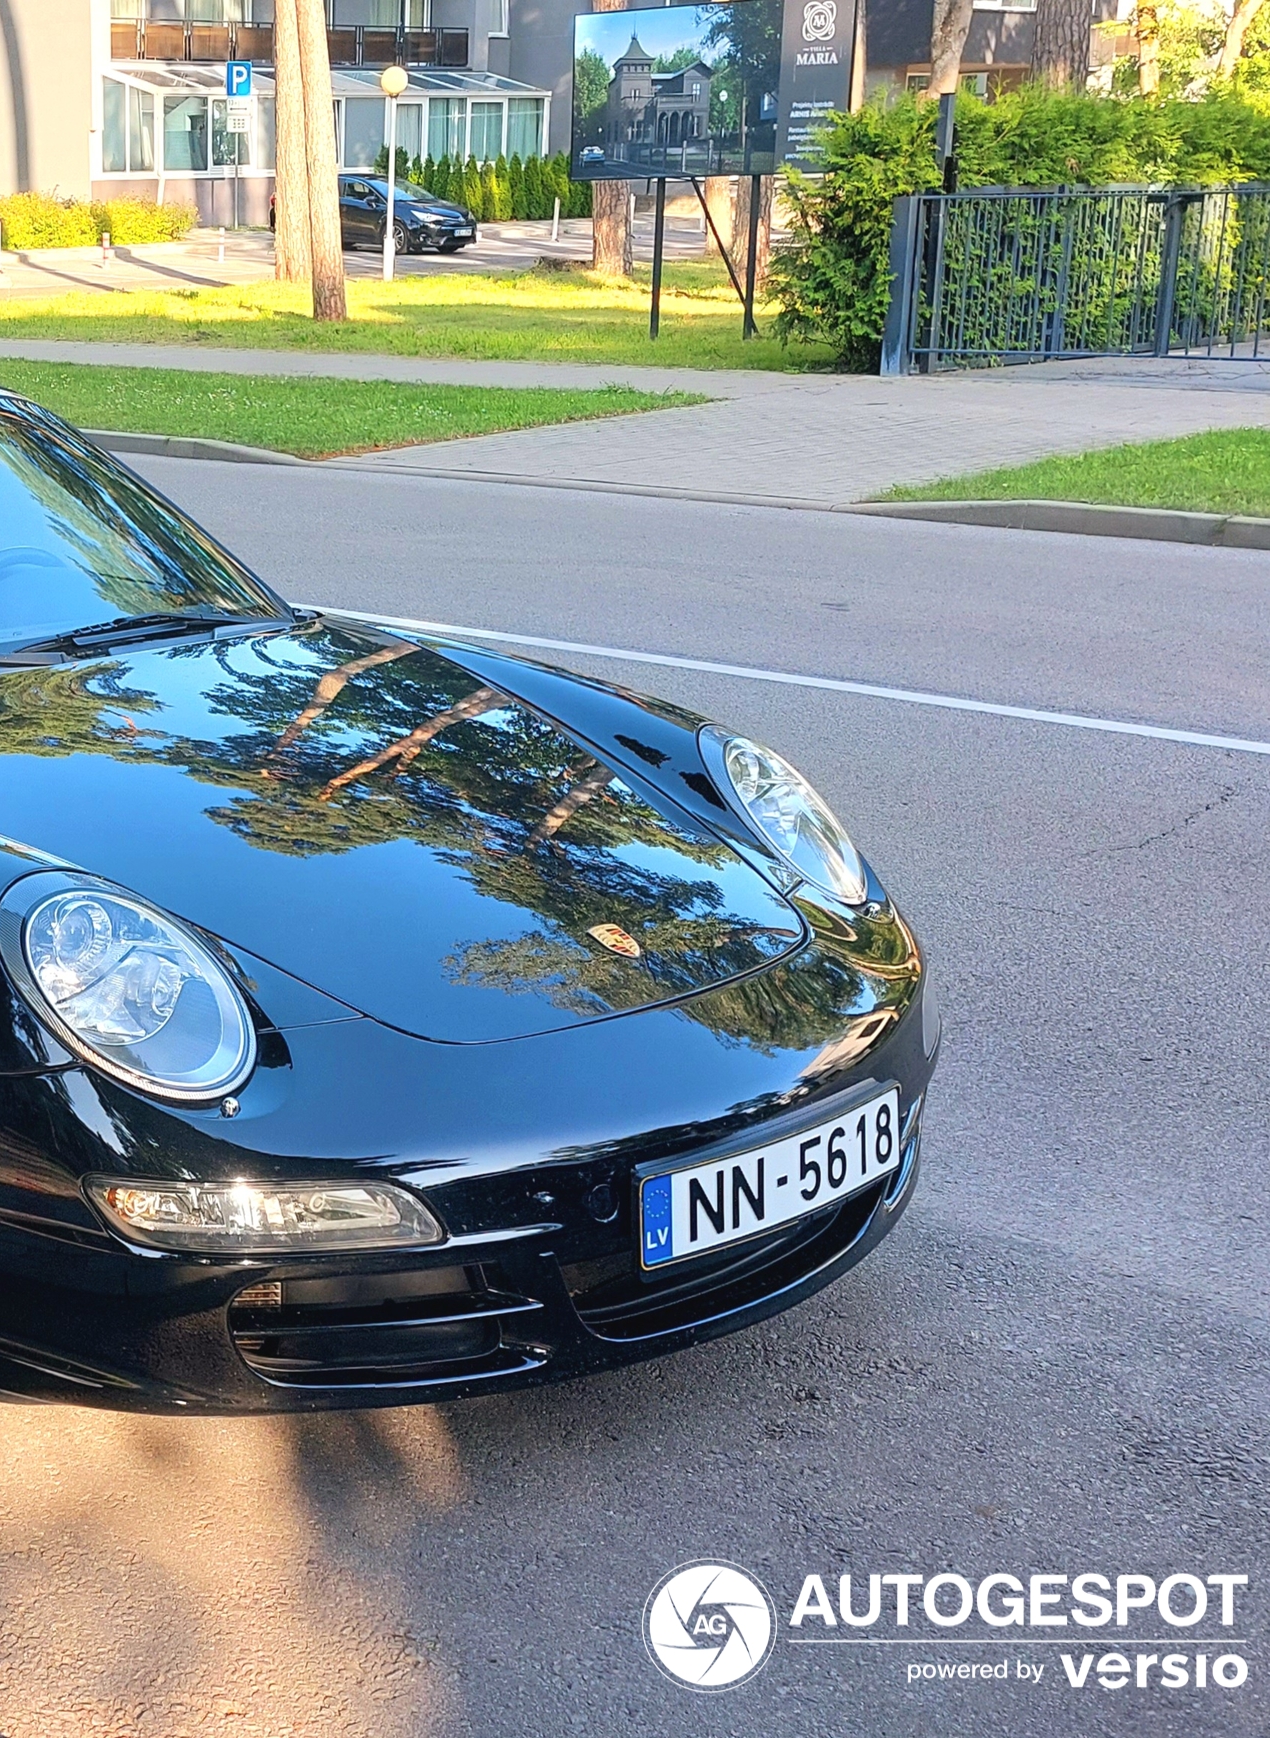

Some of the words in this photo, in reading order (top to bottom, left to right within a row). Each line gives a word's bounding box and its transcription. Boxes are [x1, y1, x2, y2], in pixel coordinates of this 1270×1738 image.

[796, 52, 838, 66] MARIA
[232, 65, 248, 94] P
[689, 1104, 893, 1242] NN-5618
[646, 1226, 669, 1250] LV
